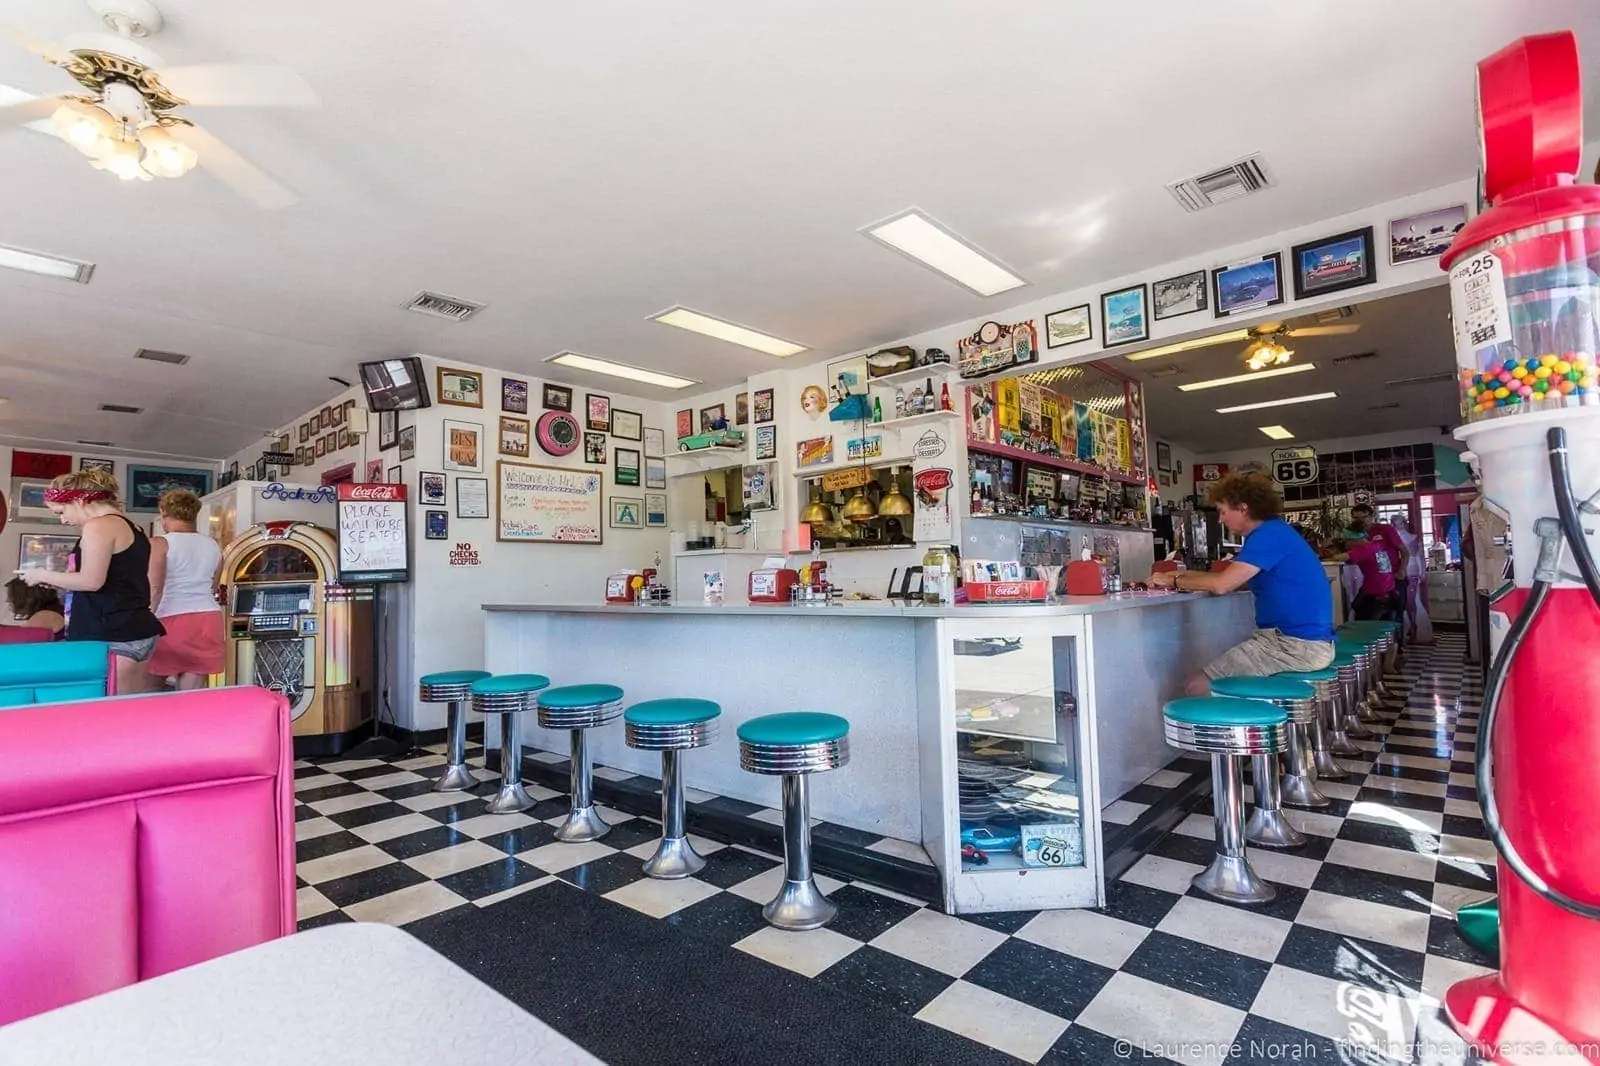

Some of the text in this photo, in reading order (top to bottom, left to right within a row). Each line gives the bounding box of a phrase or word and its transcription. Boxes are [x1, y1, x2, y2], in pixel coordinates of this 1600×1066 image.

[1468, 254, 1494, 277] .25
[504, 467, 542, 483] Welcome
[1277, 461, 1311, 481] 66
[262, 483, 304, 501] Rock
[352, 486, 393, 499] Coca-Cola
[344, 505, 392, 519] PLEASE
[375, 520, 386, 529] TO
[348, 530, 401, 543] SEATED
[1041, 847, 1061, 864] 66
